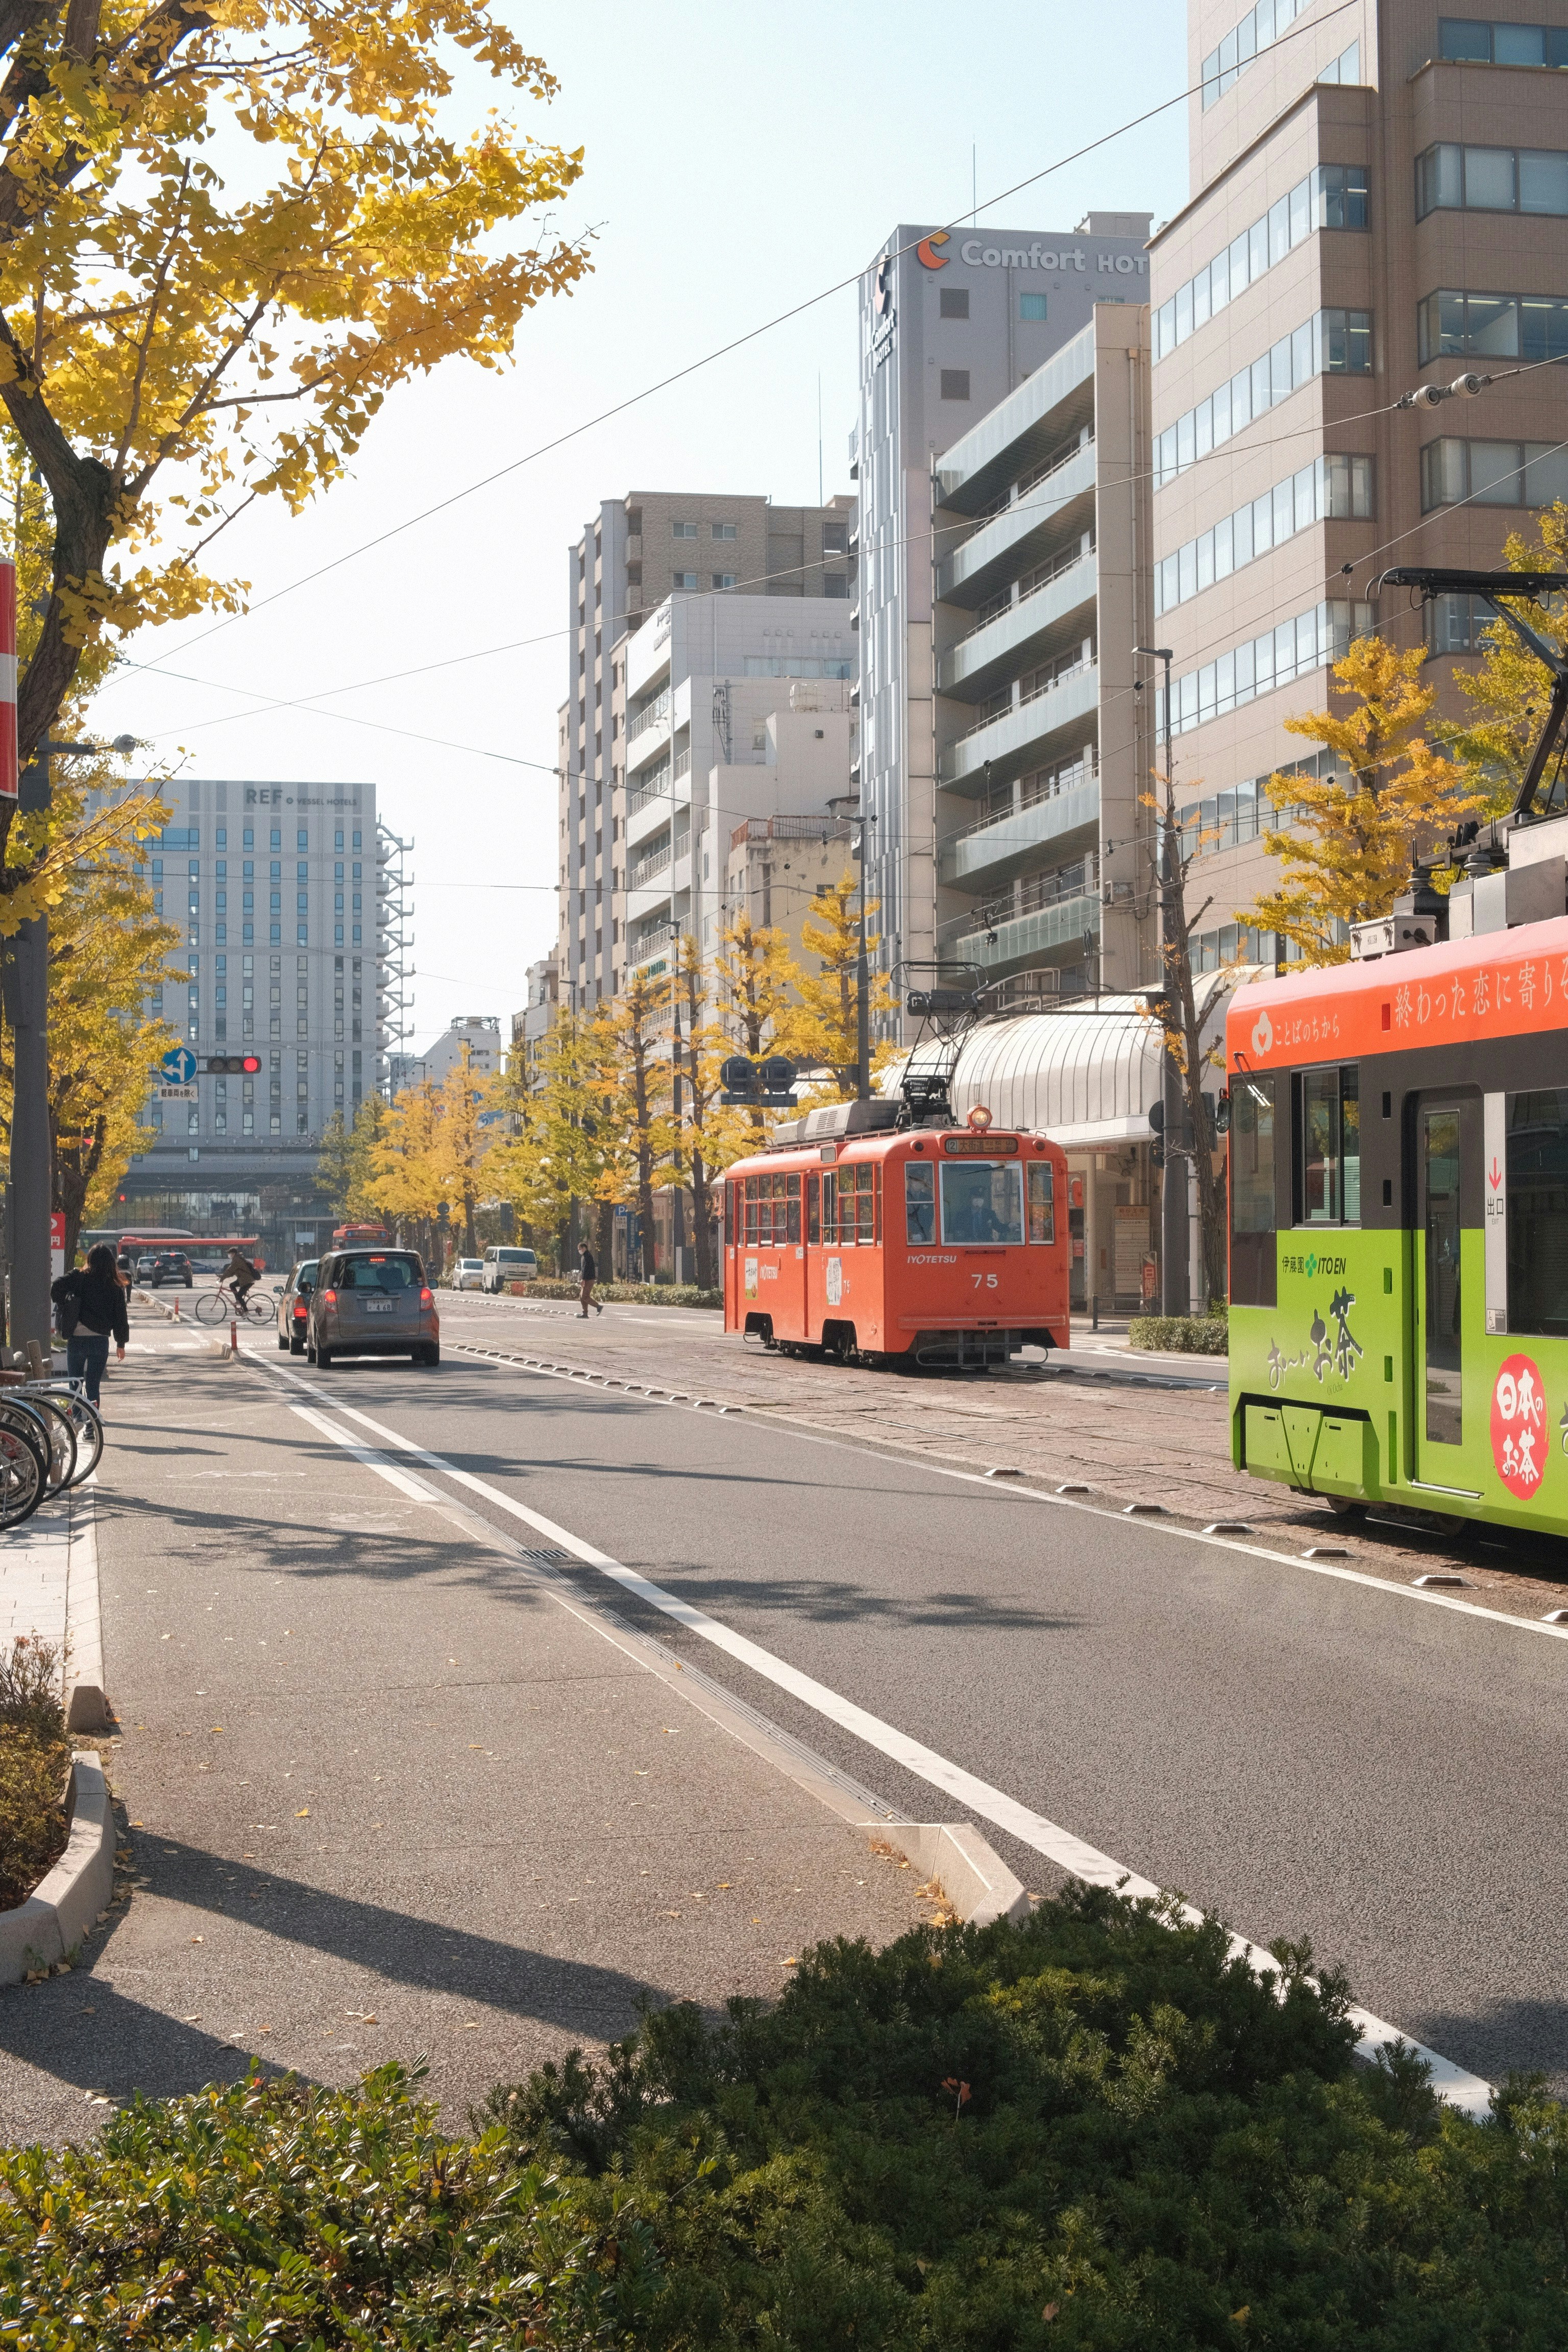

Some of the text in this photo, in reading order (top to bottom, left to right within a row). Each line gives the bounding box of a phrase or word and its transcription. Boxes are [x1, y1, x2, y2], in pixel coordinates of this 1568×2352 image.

[961, 239, 1086, 272] Comfort
[871, 308, 896, 352] Comfort
[876, 337, 892, 367] HOTEL
[246, 789, 282, 804] REF
[1276, 1013, 1339, 1045] ことばのちから
[161, 1089, 194, 1097] 軽車両を除く
[1487, 1197, 1503, 1216] 出口
[907, 1255, 957, 1264] IYOTETSU
[1282, 1256, 1304, 1273] 伊藤園
[971, 1274, 998, 1288] 75
[1497, 1368, 1543, 1428] 日本の
[1502, 1427, 1539, 1485] お茶
